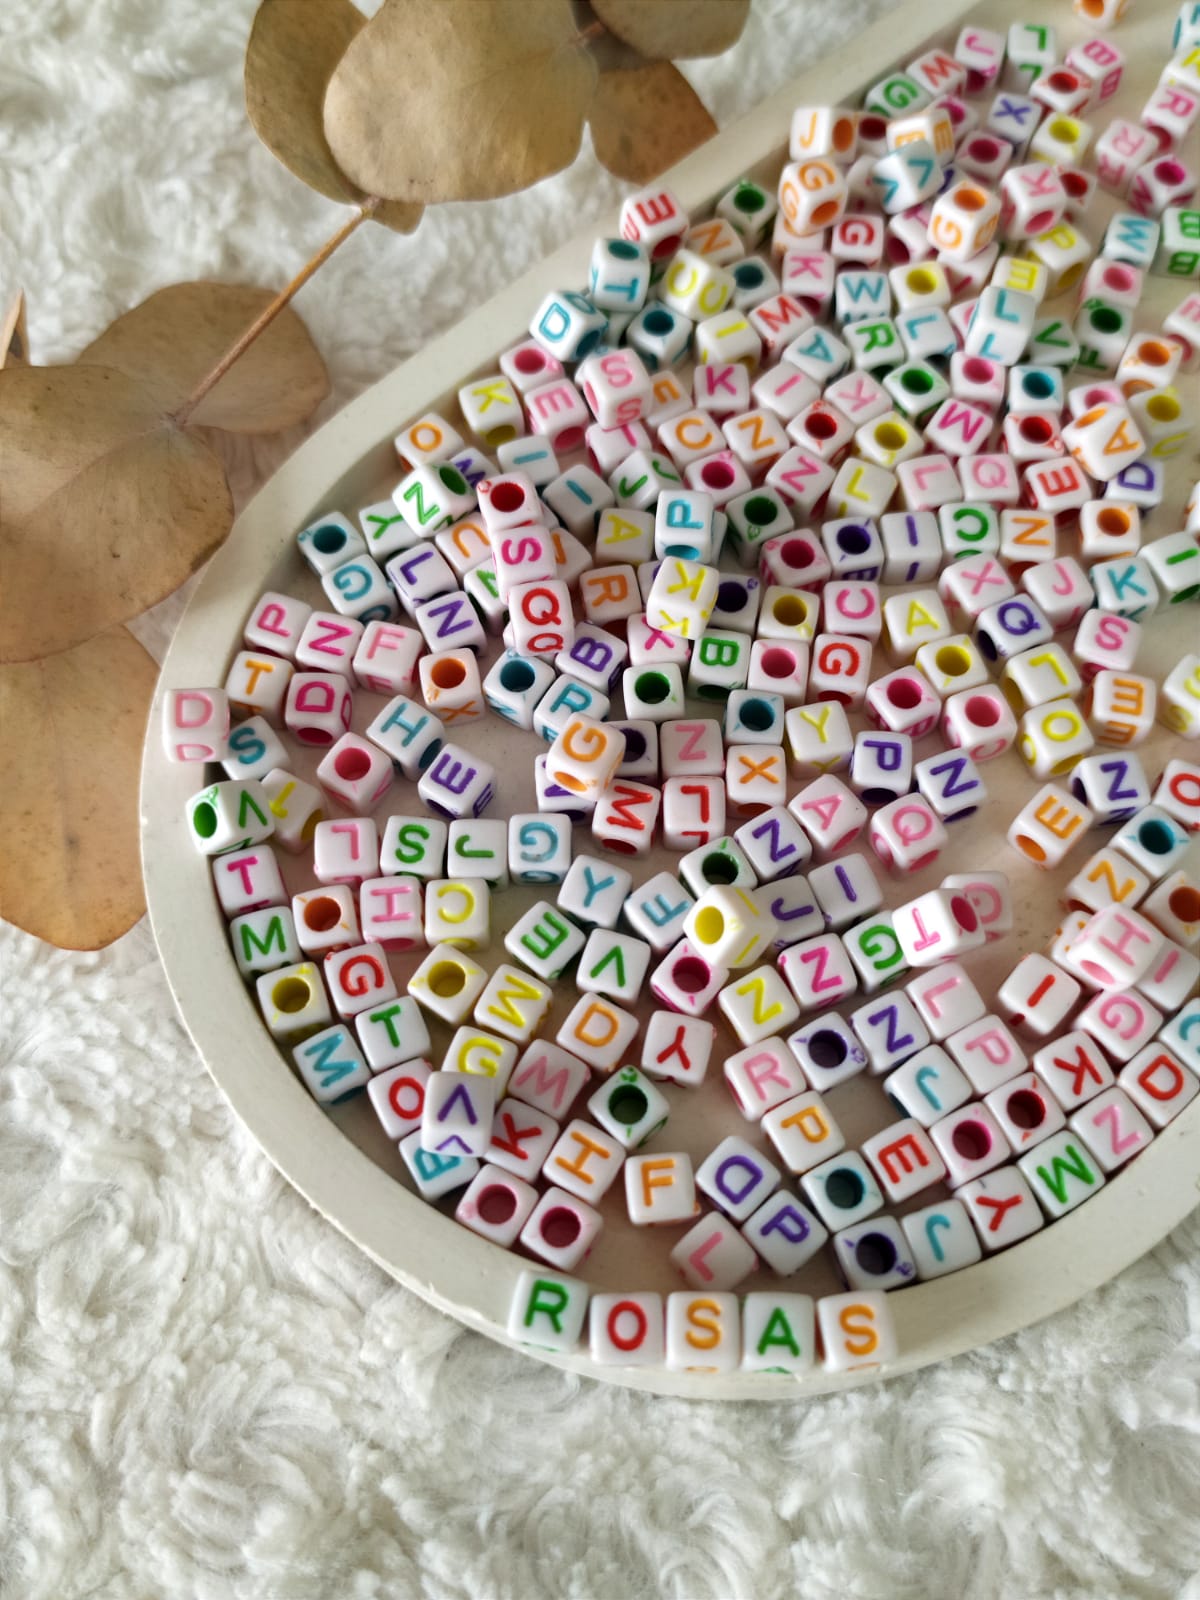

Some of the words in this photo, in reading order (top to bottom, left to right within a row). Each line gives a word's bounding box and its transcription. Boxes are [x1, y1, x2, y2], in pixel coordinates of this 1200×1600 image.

[965, 34, 993, 55] J
[1025, 25, 1048, 51] L
[883, 79, 919, 108] G
[995, 99, 1031, 124] X
[800, 113, 817, 147] J
[799, 162, 835, 190] G
[635, 193, 676, 225] E
[840, 219, 875, 244] G
[791, 256, 824, 278] K
[1006, 258, 1038, 291] E
[607, 279, 639, 299] T
[845, 279, 882, 299] W
[997, 291, 1019, 321] L
[540, 303, 570, 341] D
[715, 320, 749, 339] I
[856, 322, 896, 352] R
[908, 316, 936, 338] L
[1034, 322, 1069, 347] V
[600, 354, 633, 387] S
[705, 365, 736, 395] K
[775, 374, 802, 396] I
[472, 380, 513, 413] K
[535, 388, 575, 419] E
[409, 422, 443, 452] O
[675, 418, 714, 450] C
[1104, 419, 1141, 455] A
[618, 475, 649, 497] J
[845, 466, 871, 502] L
[914, 465, 946, 489] L
[1038, 466, 1080, 496] E
[1117, 462, 1156, 492] D
[366, 513, 404, 540] Y
[603, 514, 643, 544] A
[667, 499, 704, 528] P
[906, 515, 918, 545] I
[953, 507, 991, 542] C
[400, 551, 434, 585] L
[501, 537, 543, 566] S
[1167, 547, 1200, 565] I
[335, 565, 371, 599] G
[587, 575, 629, 607] R
[666, 560, 707, 602] K
[961, 562, 1005, 595] X
[1052, 562, 1075, 595] J
[1109, 564, 1147, 599] K
[256, 603, 291, 638] P
[521, 587, 562, 626] Q
[836, 588, 876, 620] C
[905, 599, 940, 636] A
[998, 601, 1041, 636] Q
[368, 628, 405, 659] F
[1095, 615, 1130, 651] S
[570, 637, 613, 672] B
[699, 636, 741, 667] B
[818, 642, 860, 676] G
[1028, 652, 1069, 686] L
[245, 659, 274, 695] T
[175, 693, 212, 728] D
[294, 681, 335, 713] D
[1112, 678, 1145, 716] E
[384, 704, 428, 744] H
[562, 721, 608, 762] G
[800, 705, 831, 744] Y
[1041, 710, 1082, 743] O
[228, 727, 265, 765] S
[863, 739, 903, 771] P
[430, 753, 477, 794] E
[738, 755, 780, 784] X
[680, 784, 710, 824] L
[1169, 773, 1200, 807] O
[801, 795, 842, 831] A
[892, 805, 933, 846] Q
[1034, 796, 1083, 839] E
[332, 824, 360, 861] L
[394, 823, 431, 864] S
[455, 835, 495, 858] J
[520, 822, 558, 863] G
[226, 855, 259, 896] T
[584, 867, 616, 908] Y
[834, 865, 858, 902] I
[371, 886, 412, 923] H
[436, 882, 476, 925] C
[640, 894, 688, 927] F
[771, 899, 813, 921] J
[240, 915, 287, 961] M
[521, 912, 570, 960] E
[858, 924, 904, 971] G
[912, 908, 940, 952] T
[1101, 915, 1150, 965] H
[339, 954, 385, 997] G
[589, 945, 626, 988] V
[1154, 951, 1179, 983] I
[924, 978, 957, 1018] L
[1027, 974, 1056, 1008] I
[369, 1004, 402, 1048] T
[574, 1002, 619, 1048] D
[1099, 995, 1145, 1040] G
[656, 1025, 691, 1070] Y
[965, 1031, 1011, 1065] P
[744, 1053, 790, 1100] R
[1053, 1046, 1103, 1096] K
[1137, 1054, 1185, 1101] D
[388, 1076, 425, 1121] O
[438, 1084, 477, 1125] V
[917, 1067, 942, 1111] J
[490, 1113, 542, 1160] K
[780, 1106, 830, 1143] P
[555, 1131, 611, 1184] H
[878, 1134, 930, 1184] E
[641, 1159, 675, 1206] F
[715, 1155, 764, 1205] D
[760, 1205, 810, 1243] P
[976, 1194, 1023, 1232] Y
[926, 1214, 950, 1261] J
[690, 1232, 723, 1281] L
[523, 1279, 880, 1357] ROSAS
